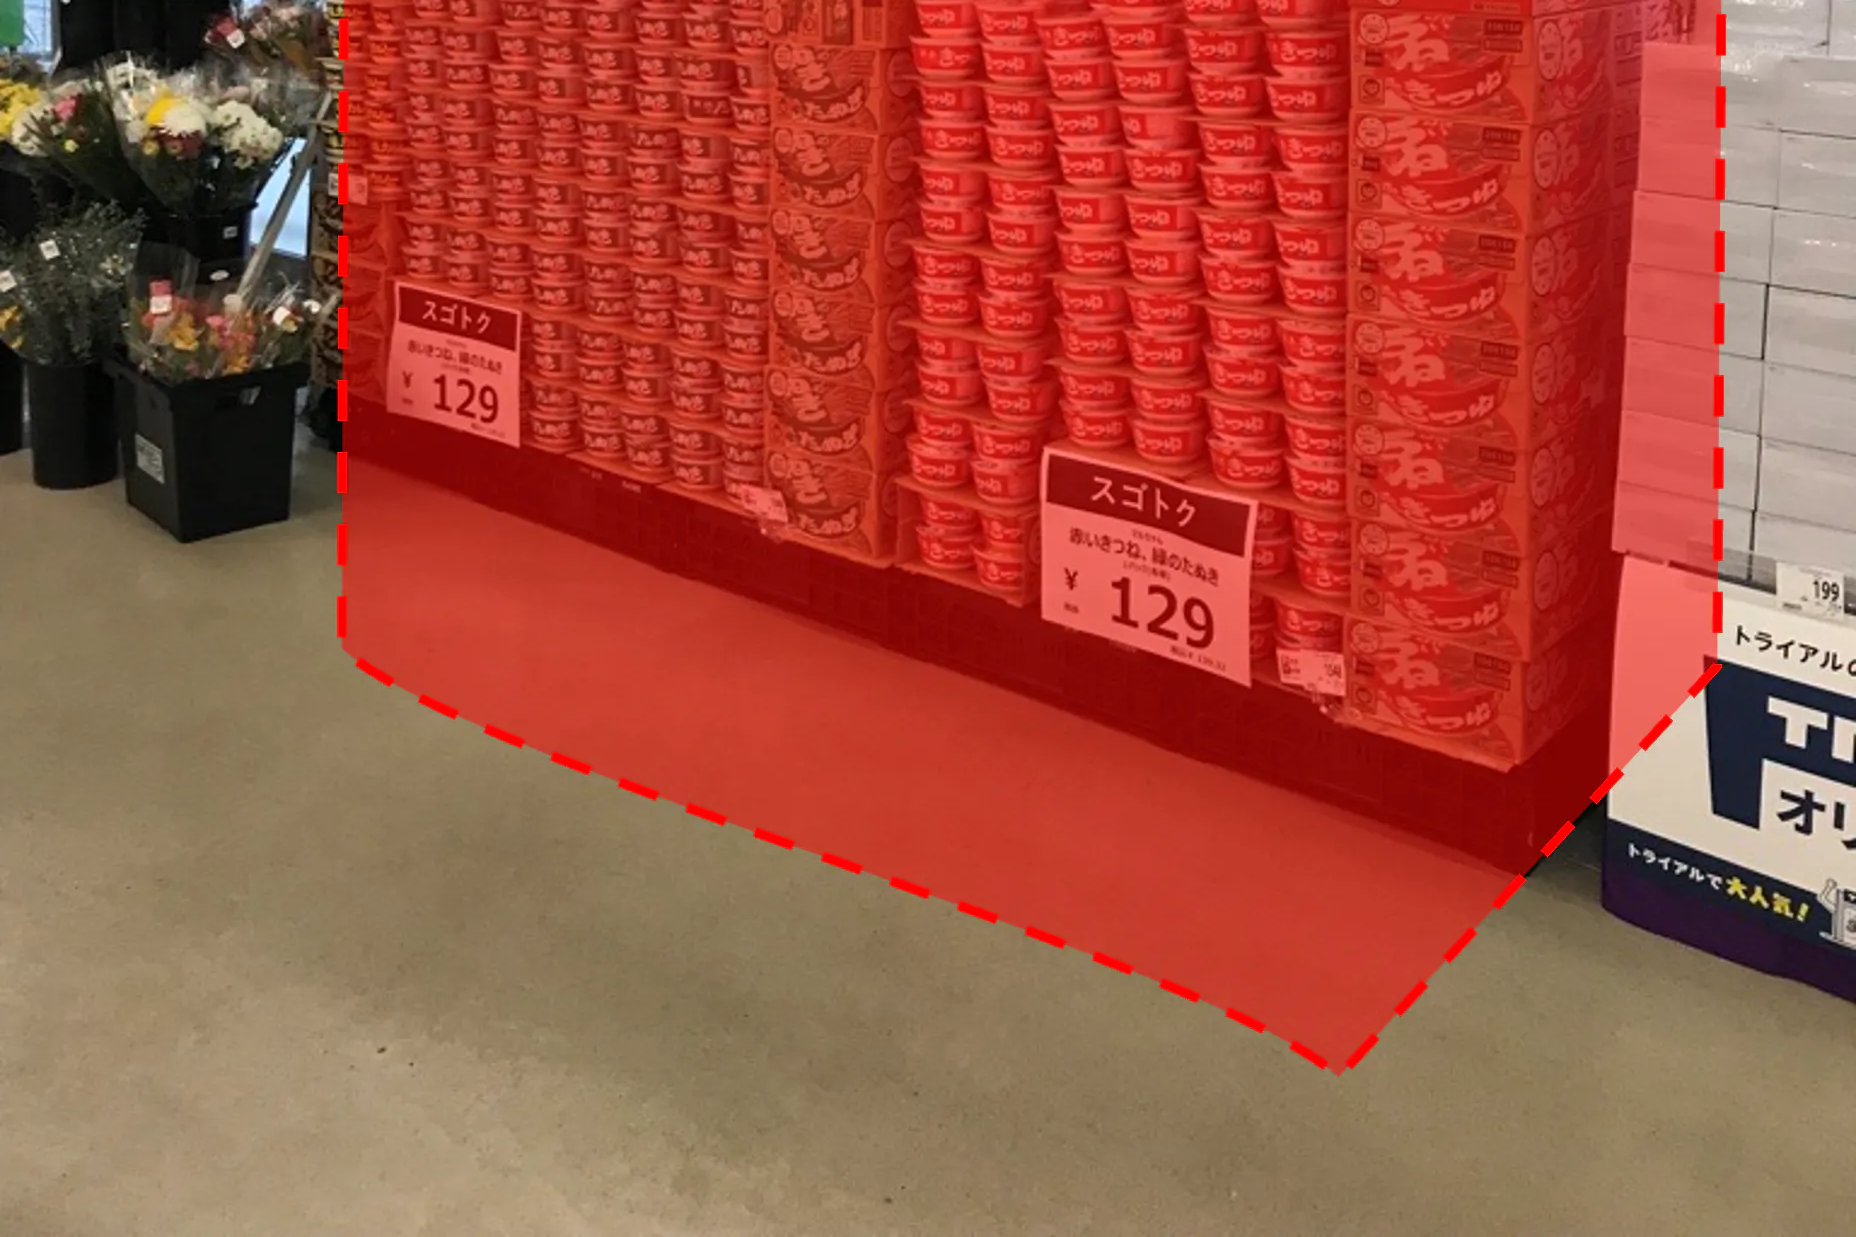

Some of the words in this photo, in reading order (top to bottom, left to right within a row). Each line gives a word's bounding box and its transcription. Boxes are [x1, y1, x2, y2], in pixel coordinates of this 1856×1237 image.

[422, 300, 492, 334] スゴトク
[433, 373, 499, 424] 129
[1090, 475, 1196, 527] スゴトク
[1110, 576, 1215, 649] 129
[1812, 579, 1840, 602] 199
